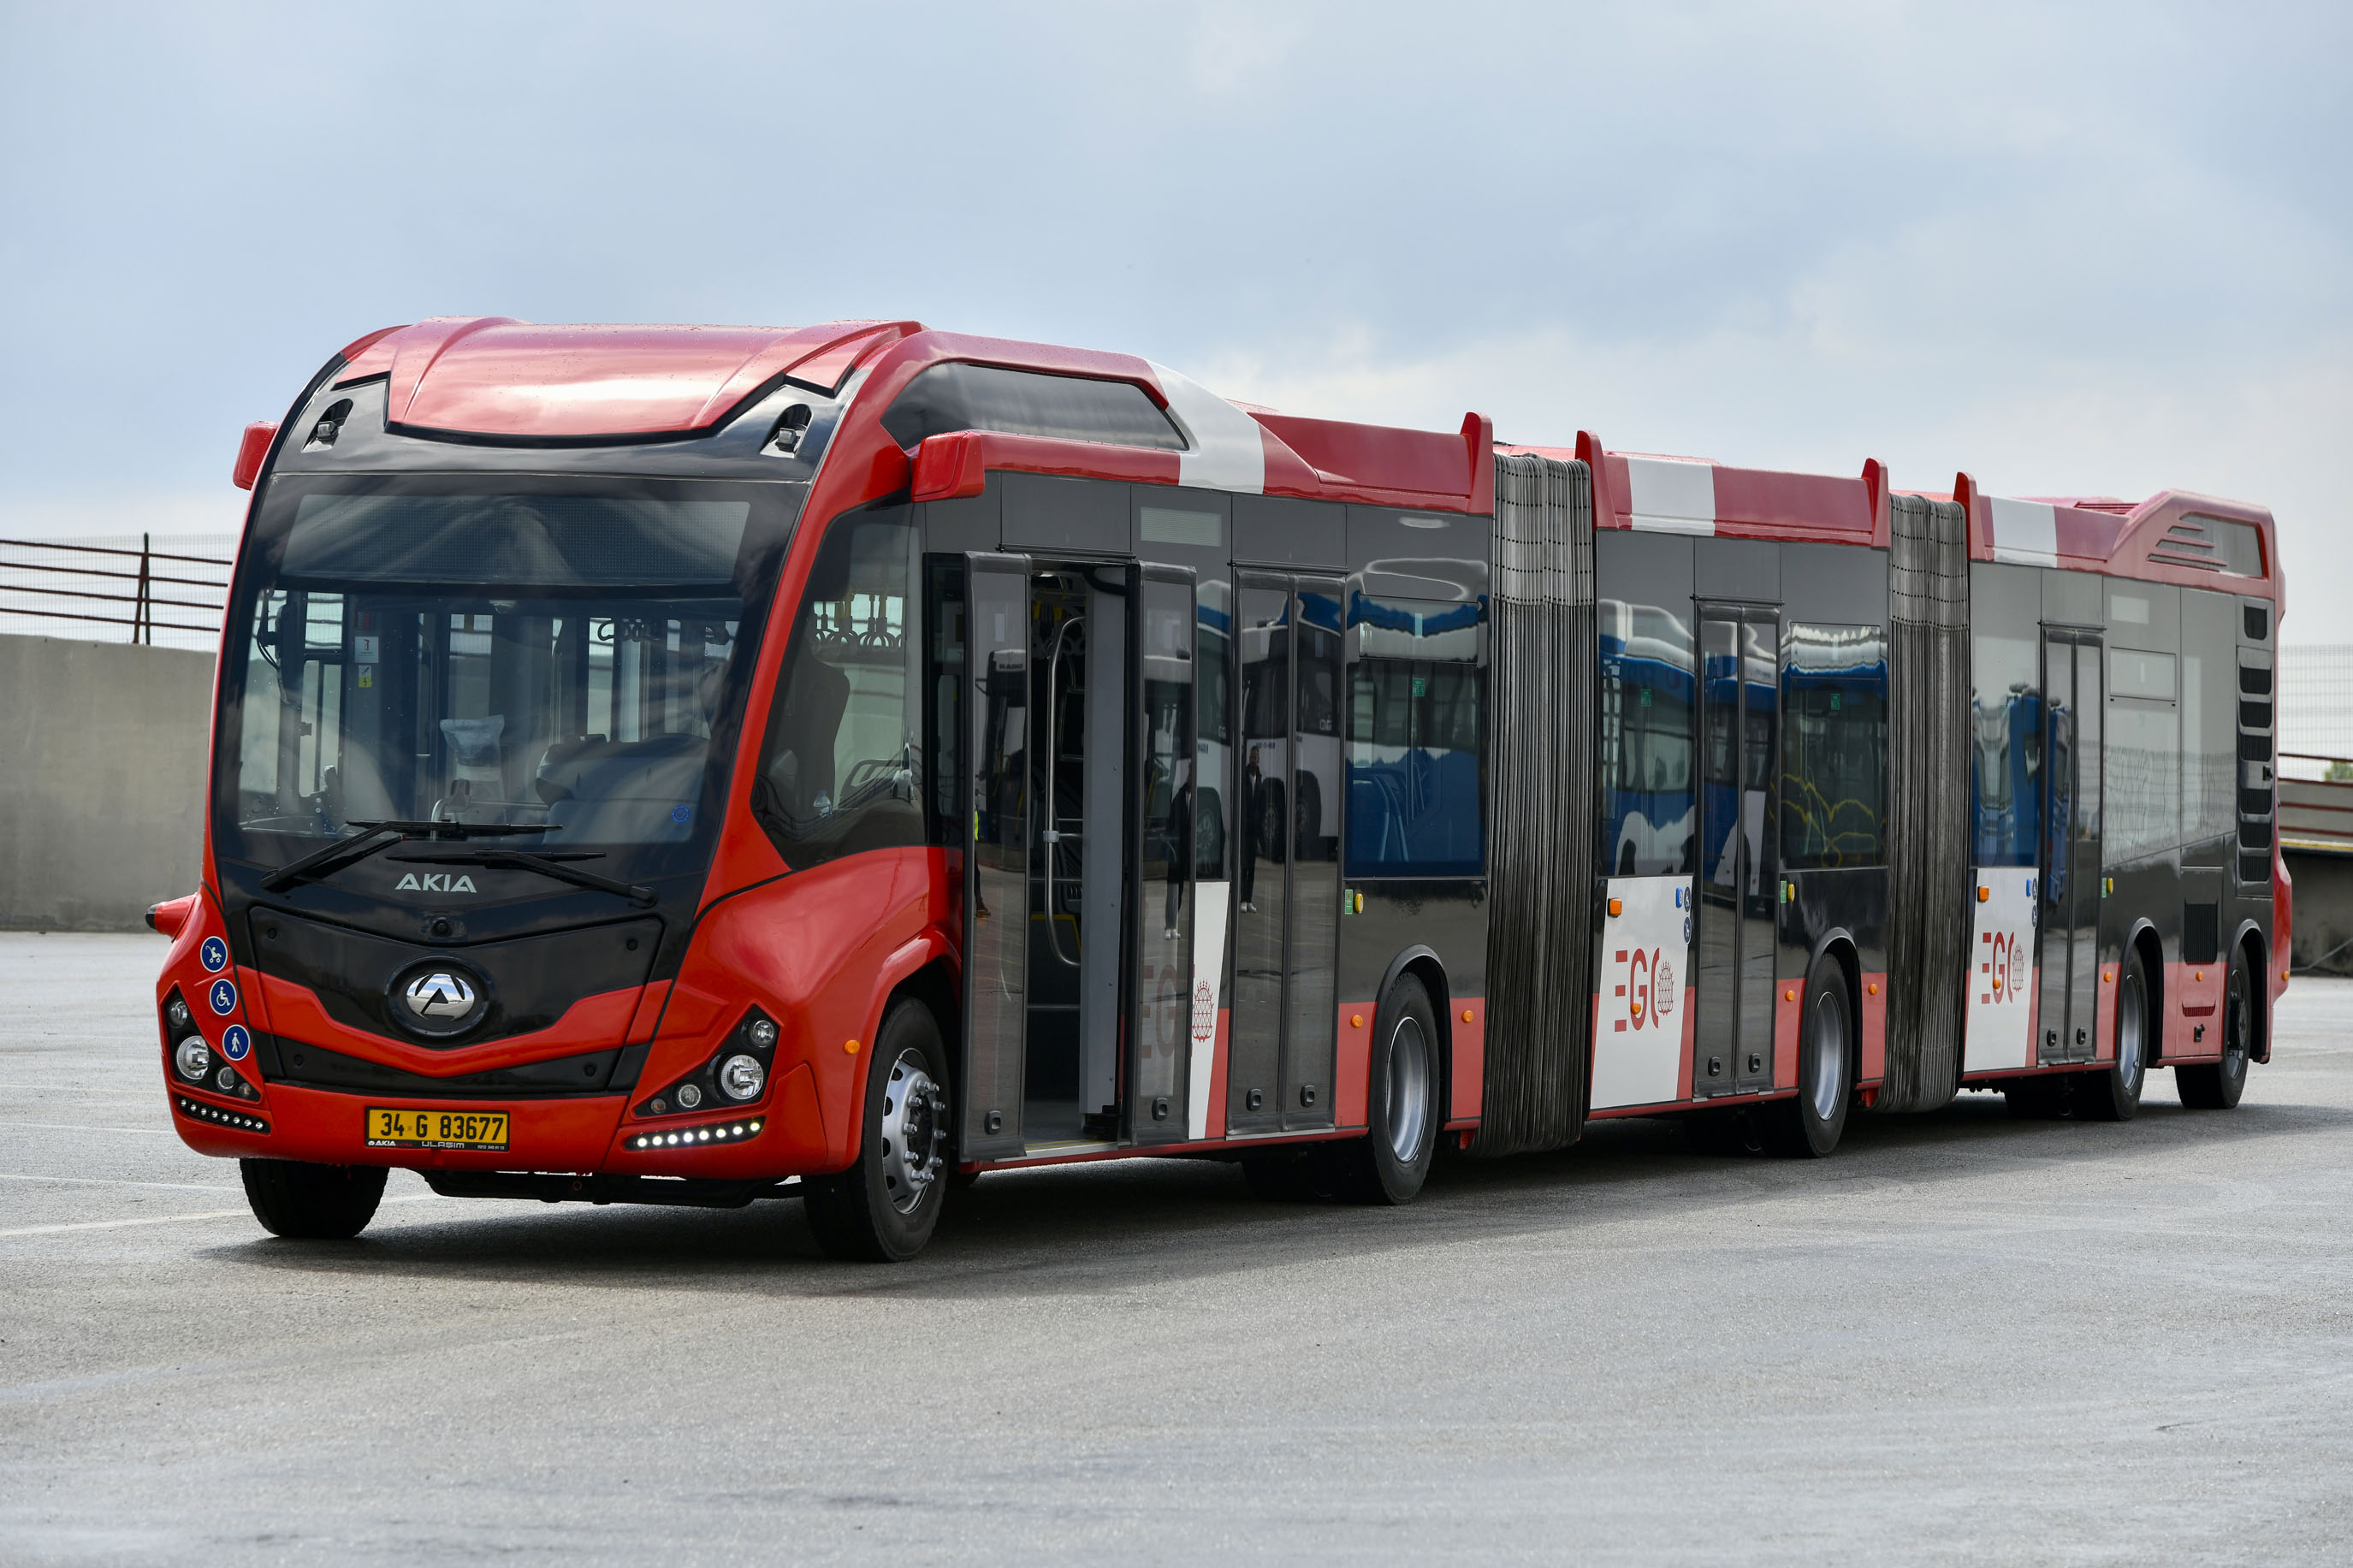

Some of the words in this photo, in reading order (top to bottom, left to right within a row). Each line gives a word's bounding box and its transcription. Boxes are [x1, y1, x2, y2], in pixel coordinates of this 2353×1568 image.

[394, 873, 477, 893] AKIA
[380, 1112, 405, 1137] 34
[416, 1114, 428, 1139] G
[439, 1115, 504, 1141] 83677
